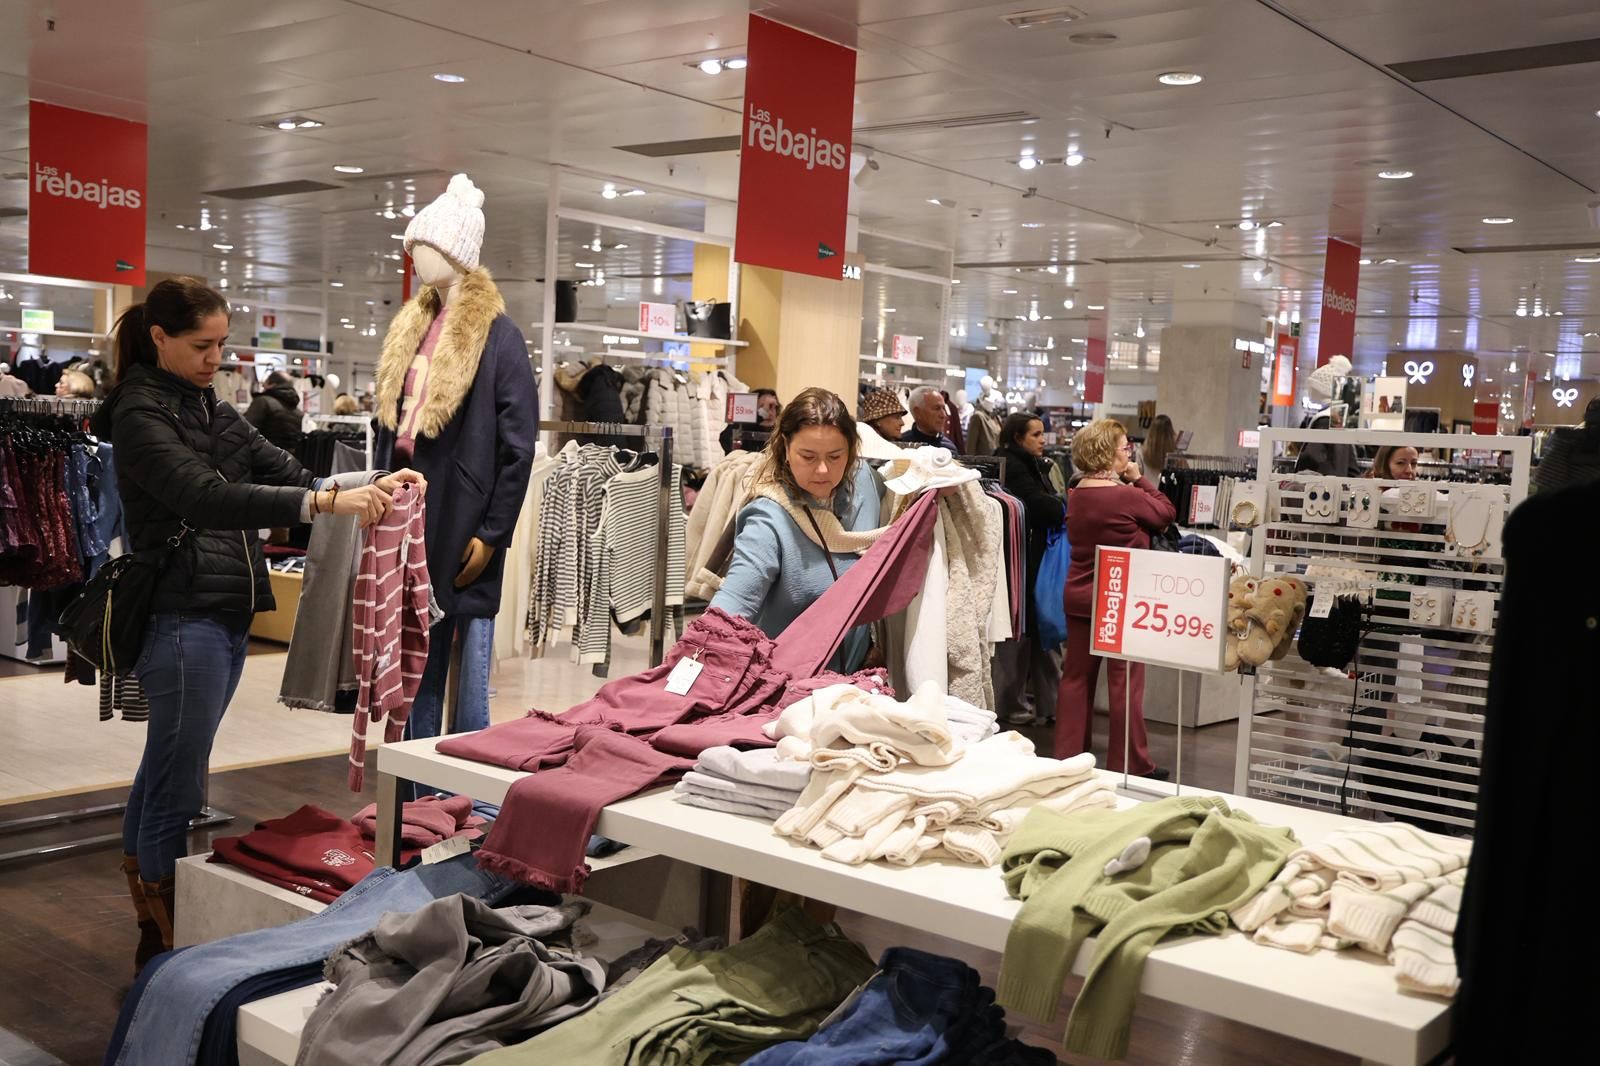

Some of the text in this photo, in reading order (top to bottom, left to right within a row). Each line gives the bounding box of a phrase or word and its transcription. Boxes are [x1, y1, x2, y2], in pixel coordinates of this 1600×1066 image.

[749, 103, 771, 123] Las
[748, 118, 846, 170] rebajas
[36, 162, 58, 176] Las
[36, 172, 141, 209] rebajas
[1323, 288, 1355, 316] rebajas
[1152, 573, 1205, 597] TODO
[1102, 566, 1123, 644] rebajas
[1131, 601, 1214, 639] 25,99€
